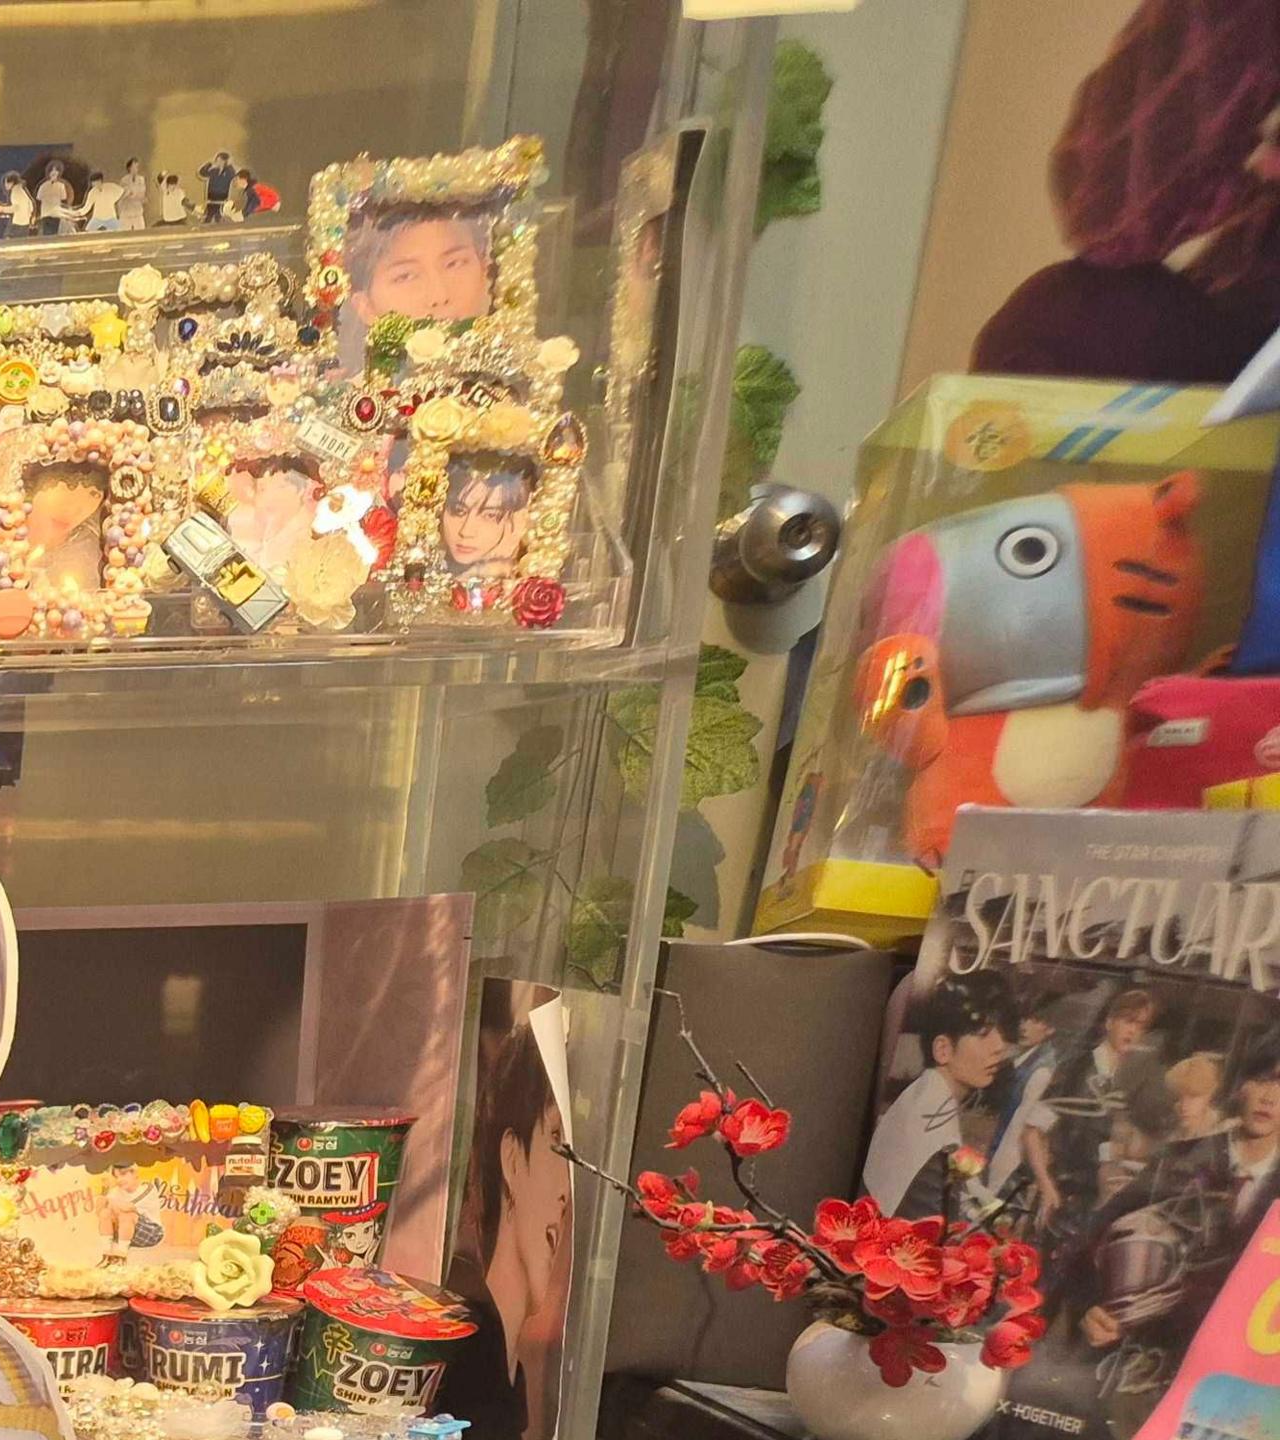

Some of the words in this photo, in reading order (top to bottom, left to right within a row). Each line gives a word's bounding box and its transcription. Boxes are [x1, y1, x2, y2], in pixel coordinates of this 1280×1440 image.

[276, 1157, 369, 1191] ZOEY
[21, 1186, 96, 1220] Happy
[307, 1194, 358, 1205] RAMYUN
[152, 1347, 244, 1385] RUMI
[340, 1354, 437, 1398] ZOEY
[335, 1387, 367, 1404] SHIN
[1012, 1403, 1083, 1435] TOGETHER
